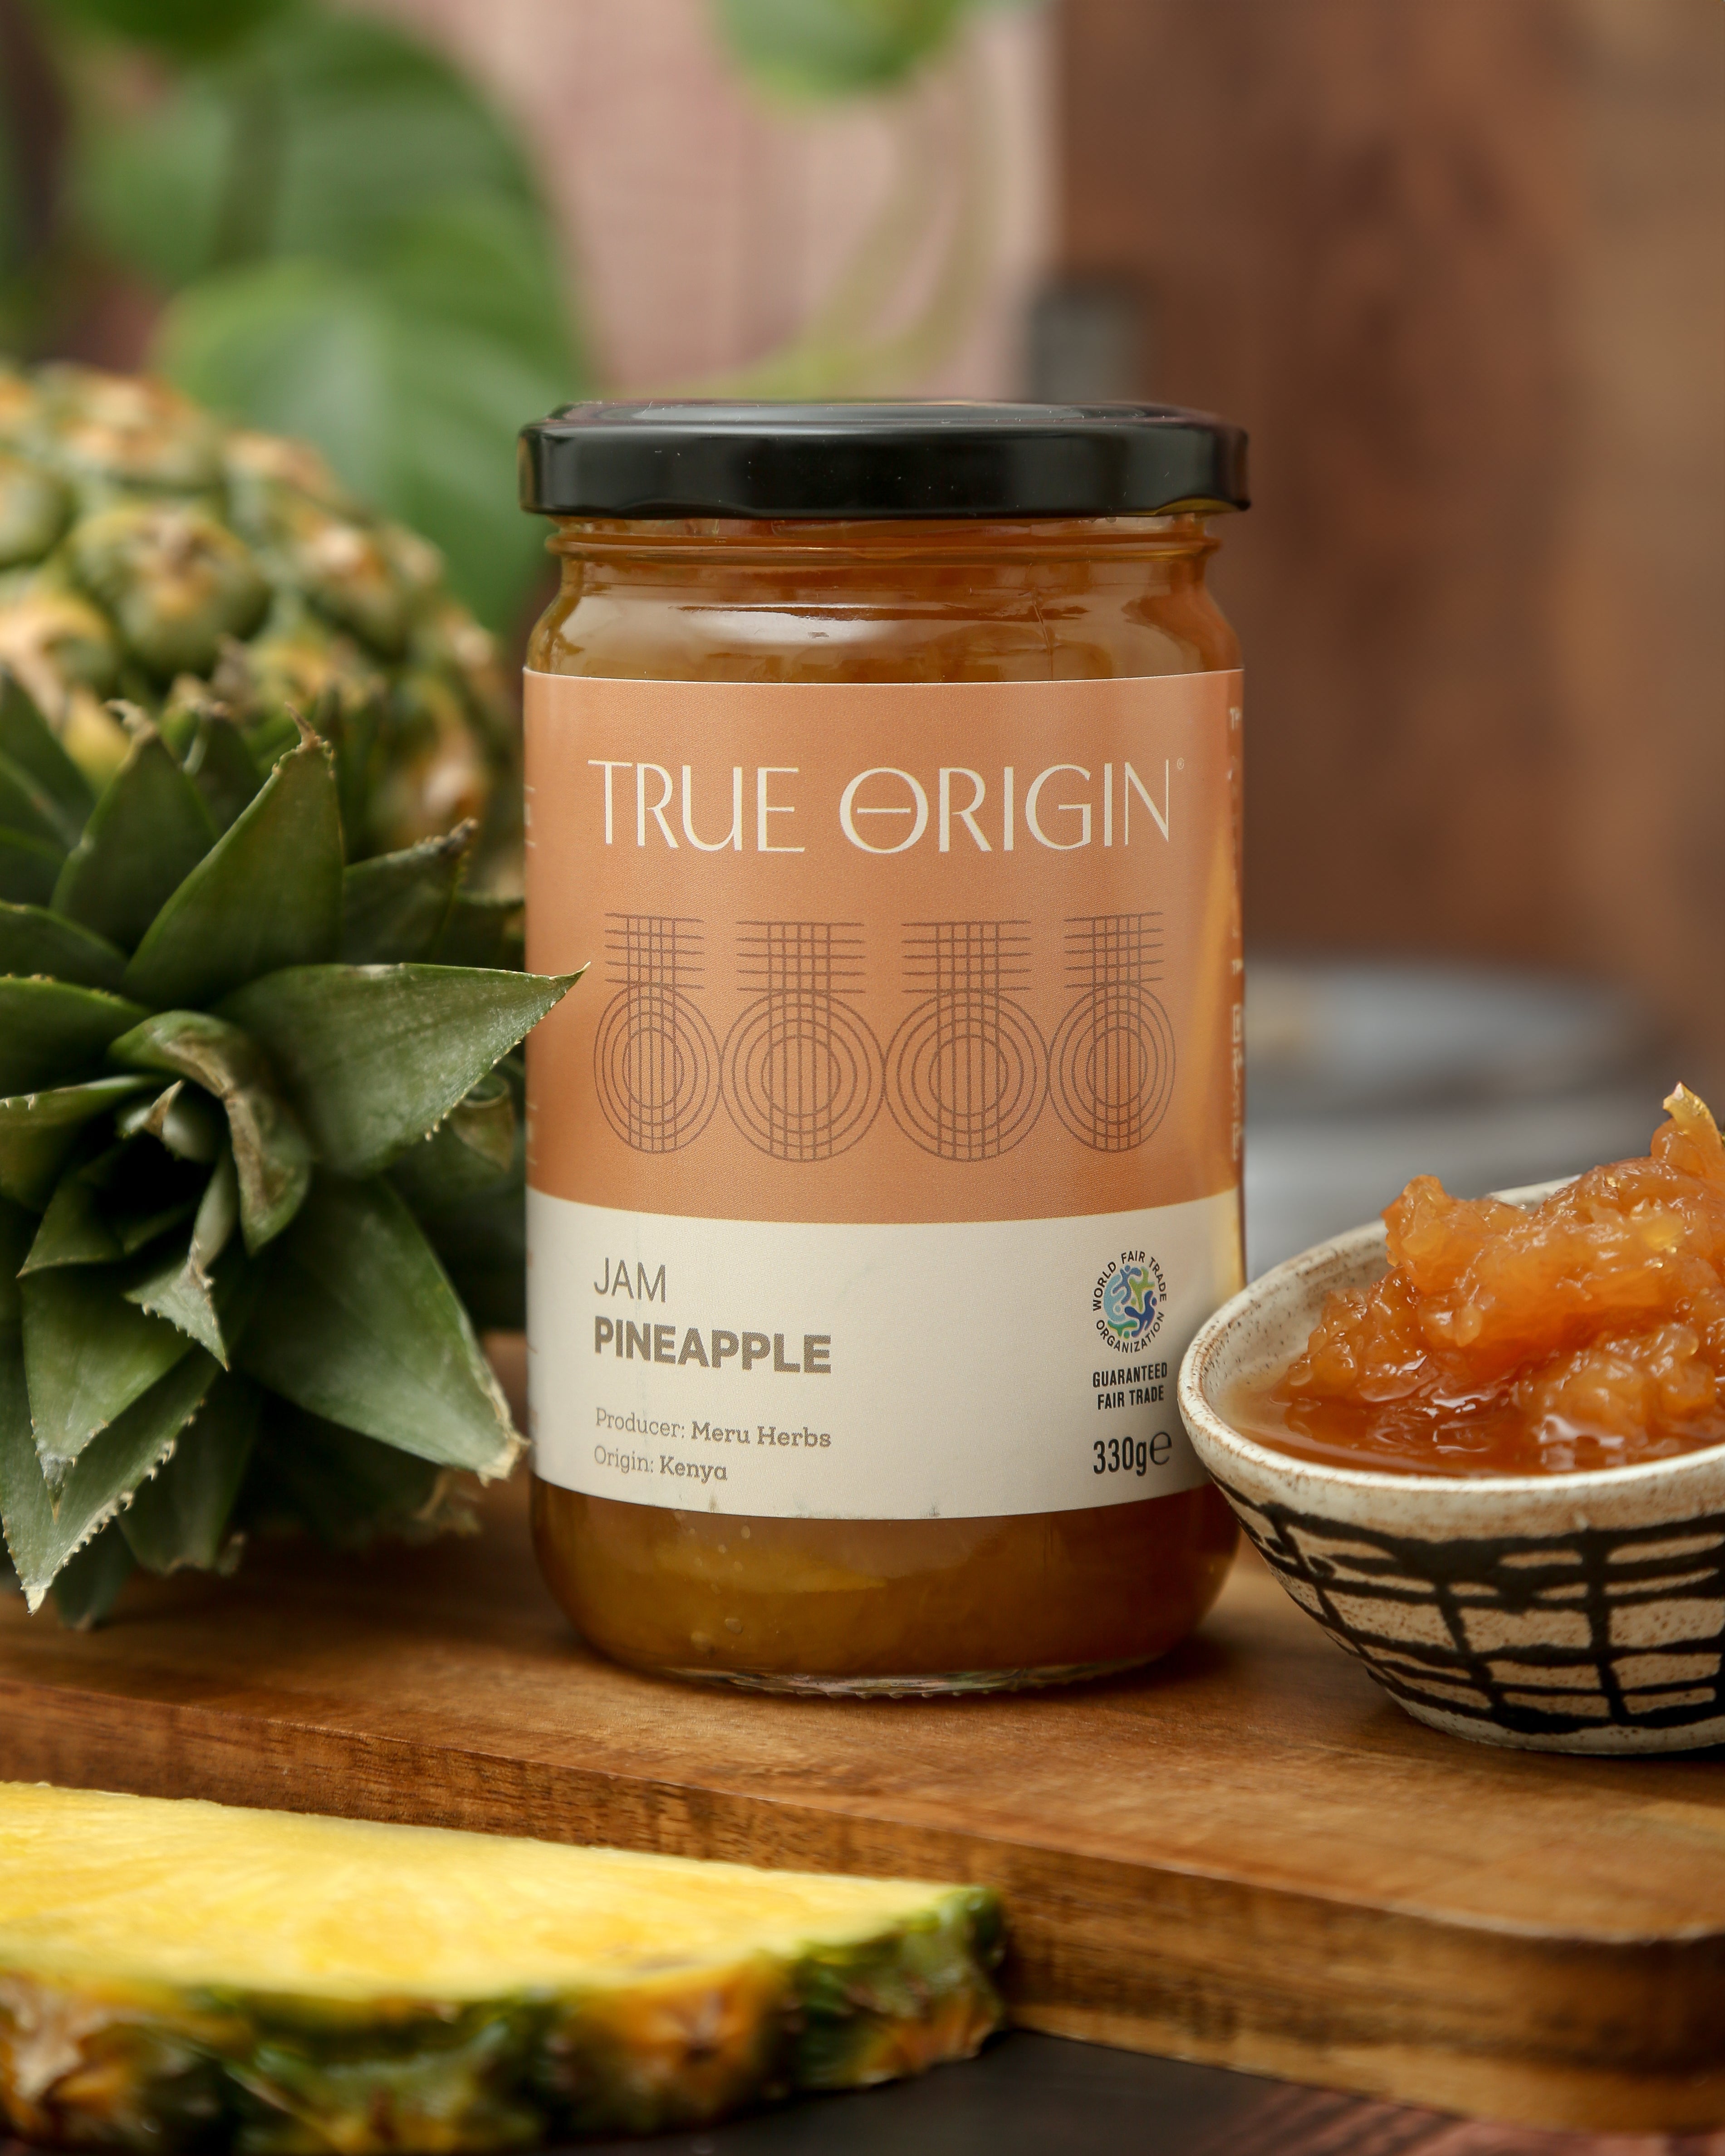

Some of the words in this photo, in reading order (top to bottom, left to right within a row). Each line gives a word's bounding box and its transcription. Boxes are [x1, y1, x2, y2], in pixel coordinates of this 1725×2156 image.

[588, 760, 805, 852] TRUE
[593, 1257, 666, 1303] JAM
[1093, 1261, 1117, 1311] WORLD
[1121, 1250, 1146, 1264] FAIR
[1149, 1256, 1167, 1302] TRADE
[594, 1315, 832, 1374] PINEAPPLE
[1096, 1311, 1165, 1353] ORGANIZATION
[1093, 1362, 1168, 1388] GUARANTEED
[1097, 1390, 1125, 1410] FAIR
[1129, 1385, 1165, 1406] TRADE
[595, 1407, 686, 1438] Producer:
[691, 1420, 751, 1445] Meru
[757, 1426, 832, 1448] Herbs
[593, 1444, 654, 1474] Origin:
[659, 1455, 728, 1484] Kenya
